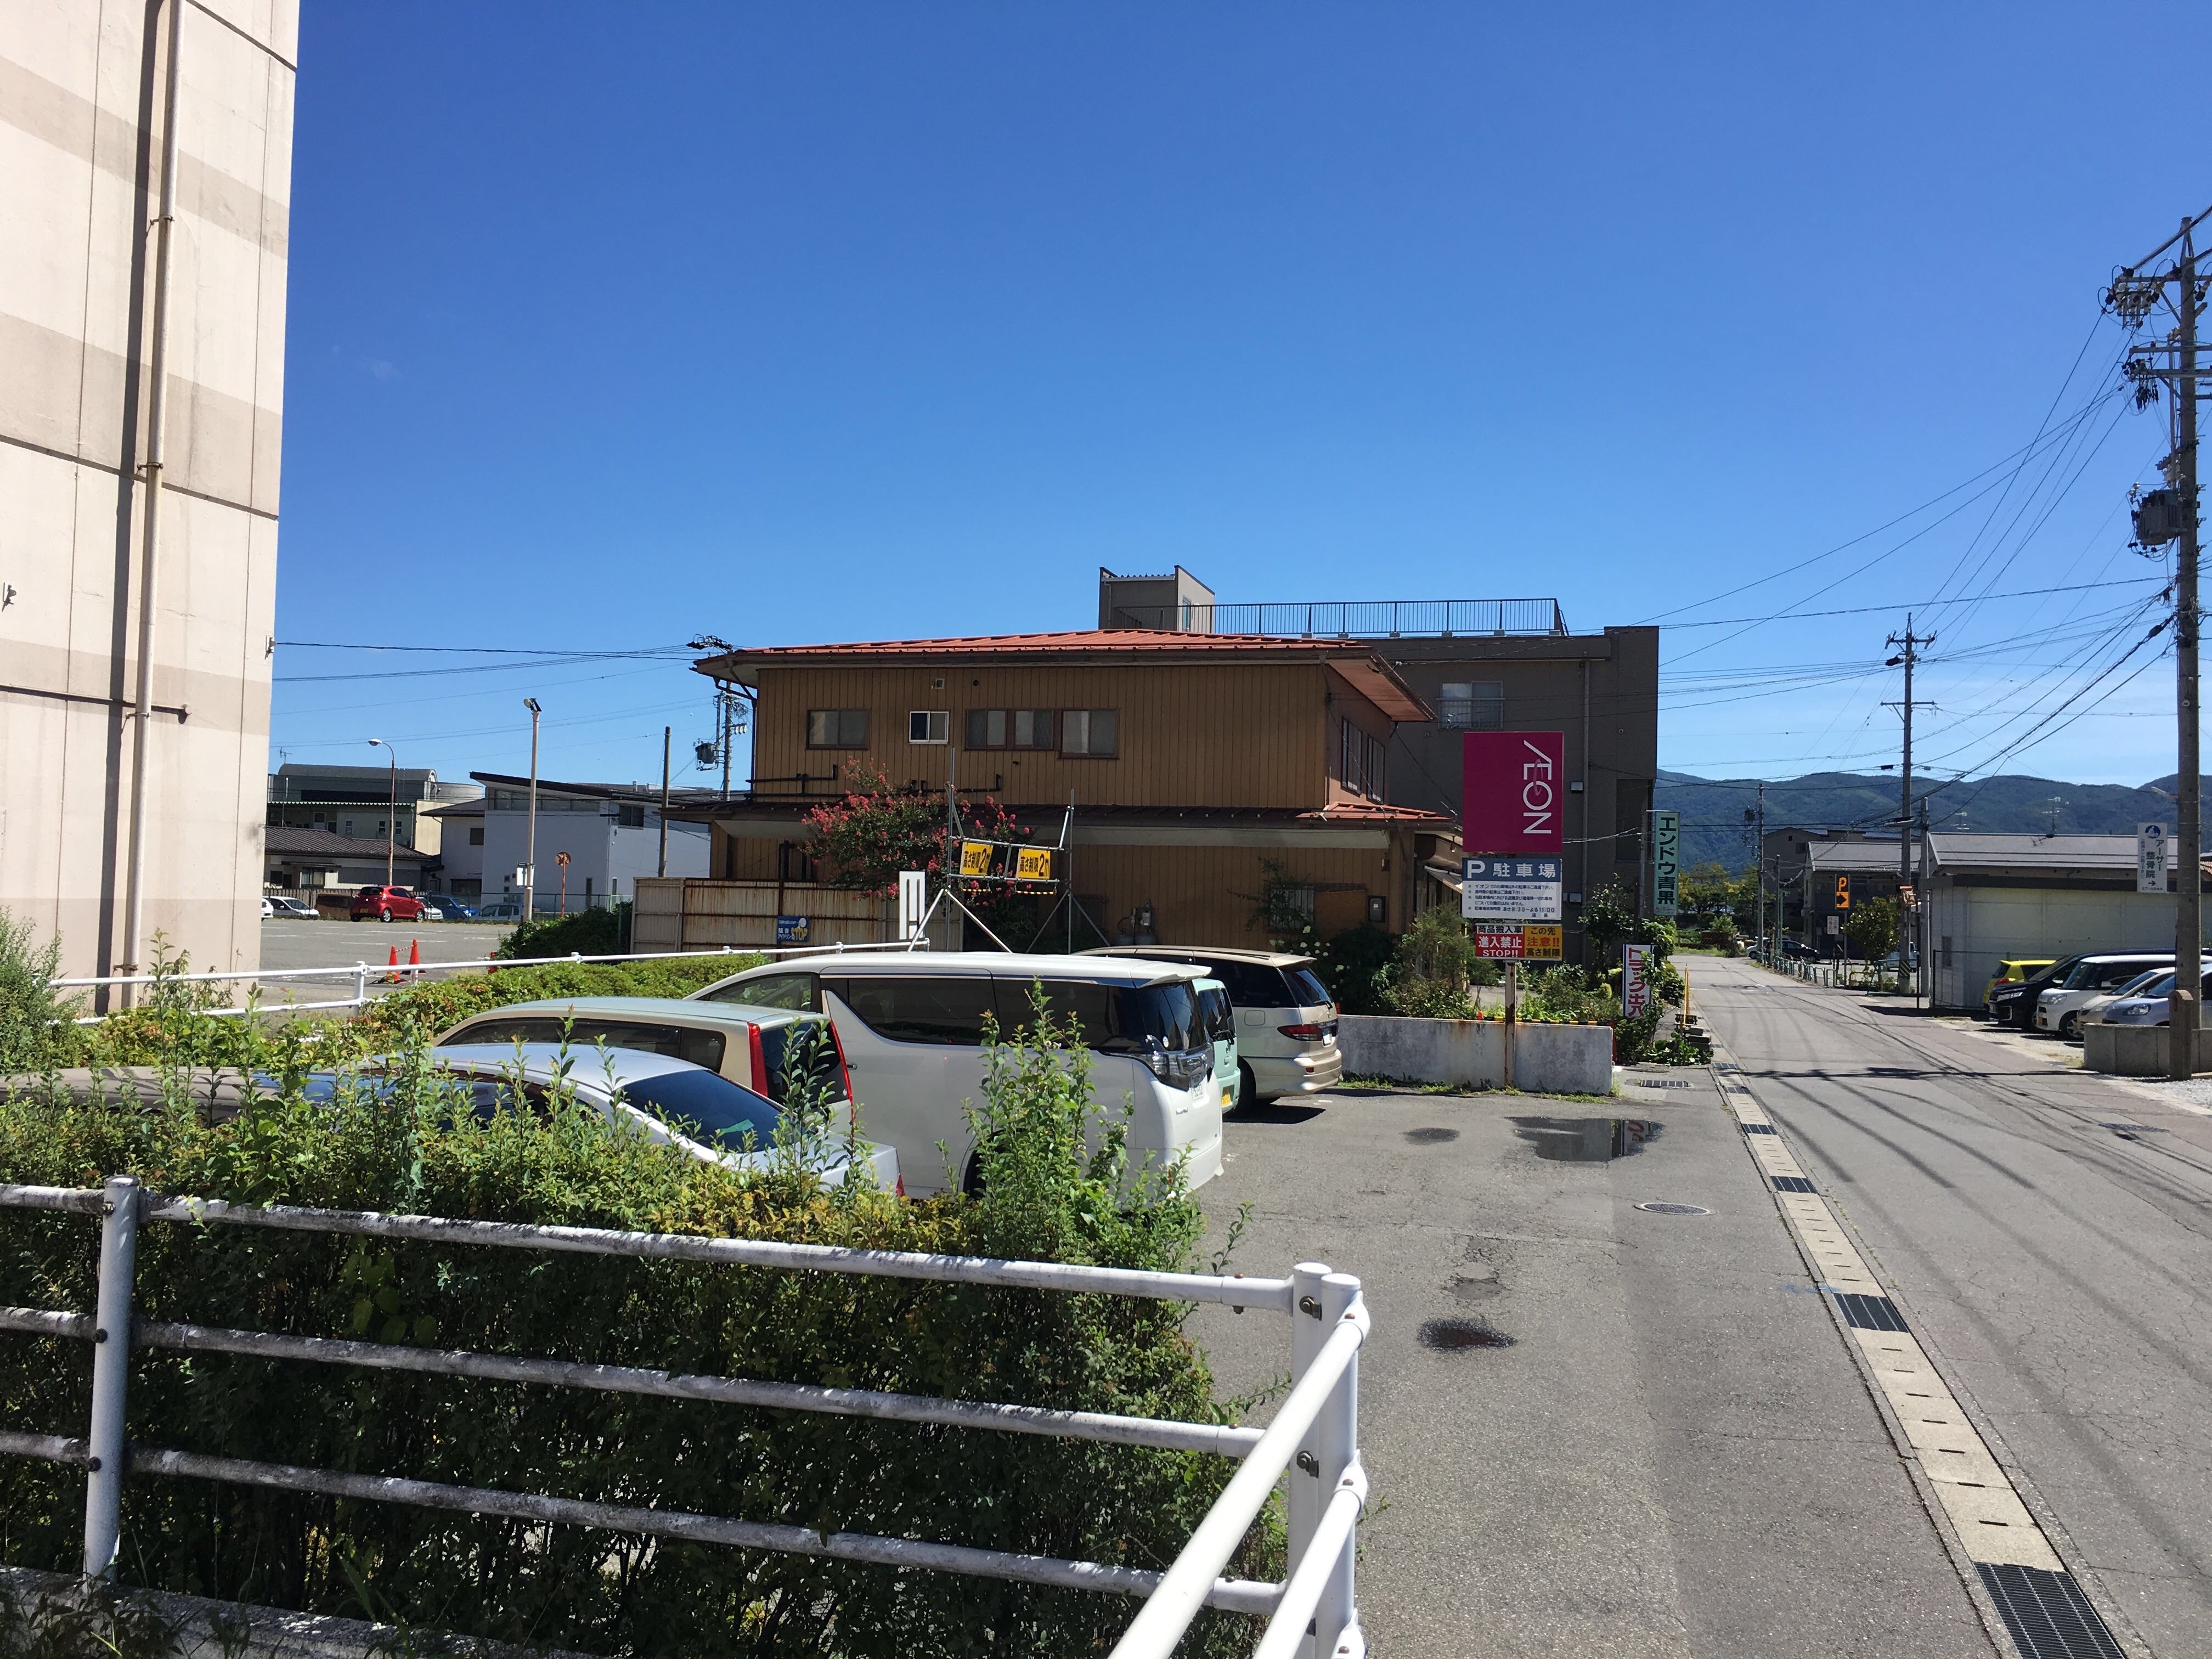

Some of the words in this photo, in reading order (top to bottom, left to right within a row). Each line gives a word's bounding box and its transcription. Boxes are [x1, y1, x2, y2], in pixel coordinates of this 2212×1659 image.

[1522, 740, 1552, 834] AEON
[1020, 853, 1049, 877] 高さ制限2m
[1657, 817, 1677, 905] エンドウ青果
[2146, 851, 2155, 878] 整骨院
[2156, 839, 2165, 871] アーサー
[1467, 860, 1485, 878] P
[1493, 863, 1556, 878] 駐車場
[1838, 877, 1847, 891] P
[1478, 936, 1522, 948] 進入禁止
[1526, 948, 1560, 957] 高さ制限
